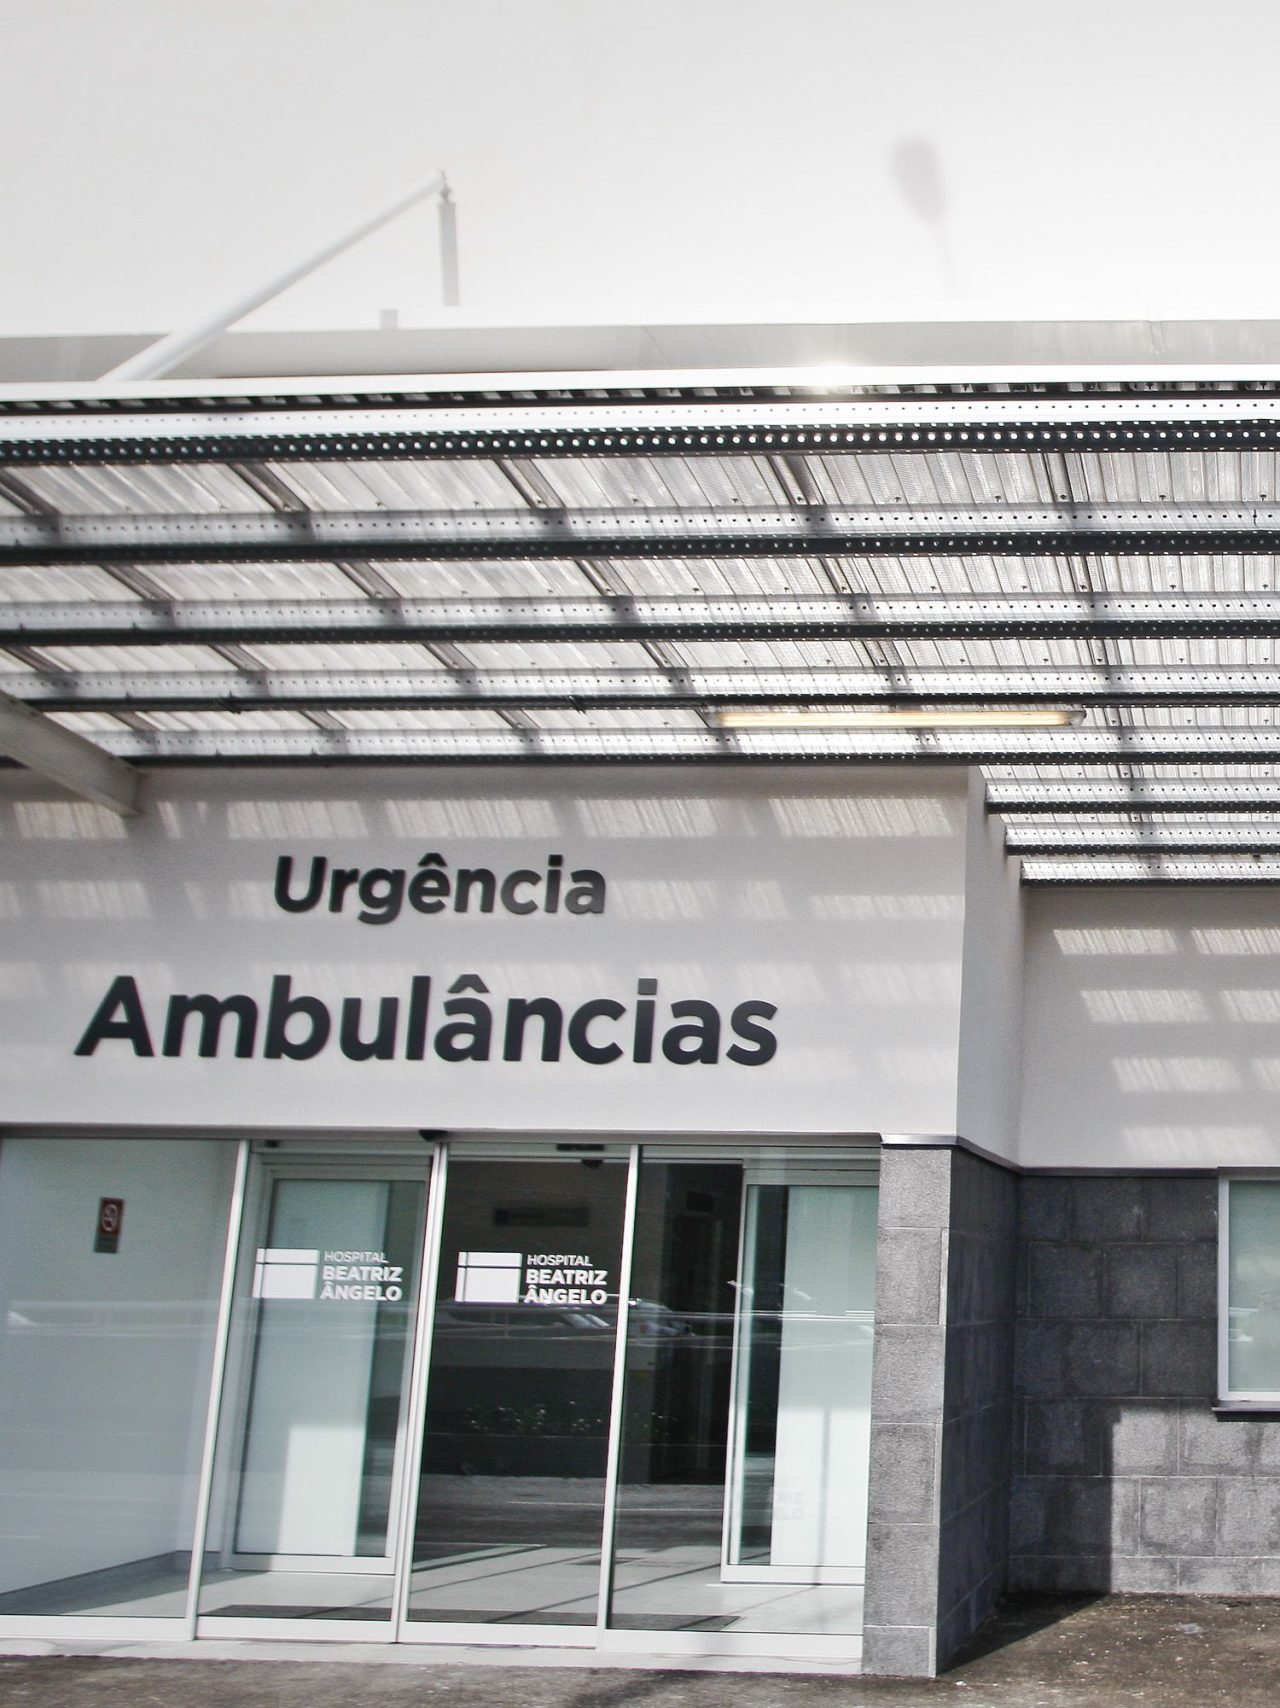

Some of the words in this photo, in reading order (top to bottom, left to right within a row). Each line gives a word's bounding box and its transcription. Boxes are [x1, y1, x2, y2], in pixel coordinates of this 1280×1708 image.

[273, 852, 606, 926] Urgência
[73, 973, 778, 1067] Ambulâncias
[324, 1250, 389, 1264] HOSPITAL
[526, 1254, 593, 1267] HOSPITAL
[322, 1265, 404, 1282] BEATRIZ
[525, 1268, 608, 1286] BEATRIZ
[320, 1280, 403, 1302] ÂNGELO
[523, 1284, 608, 1306] ÂNGELO
